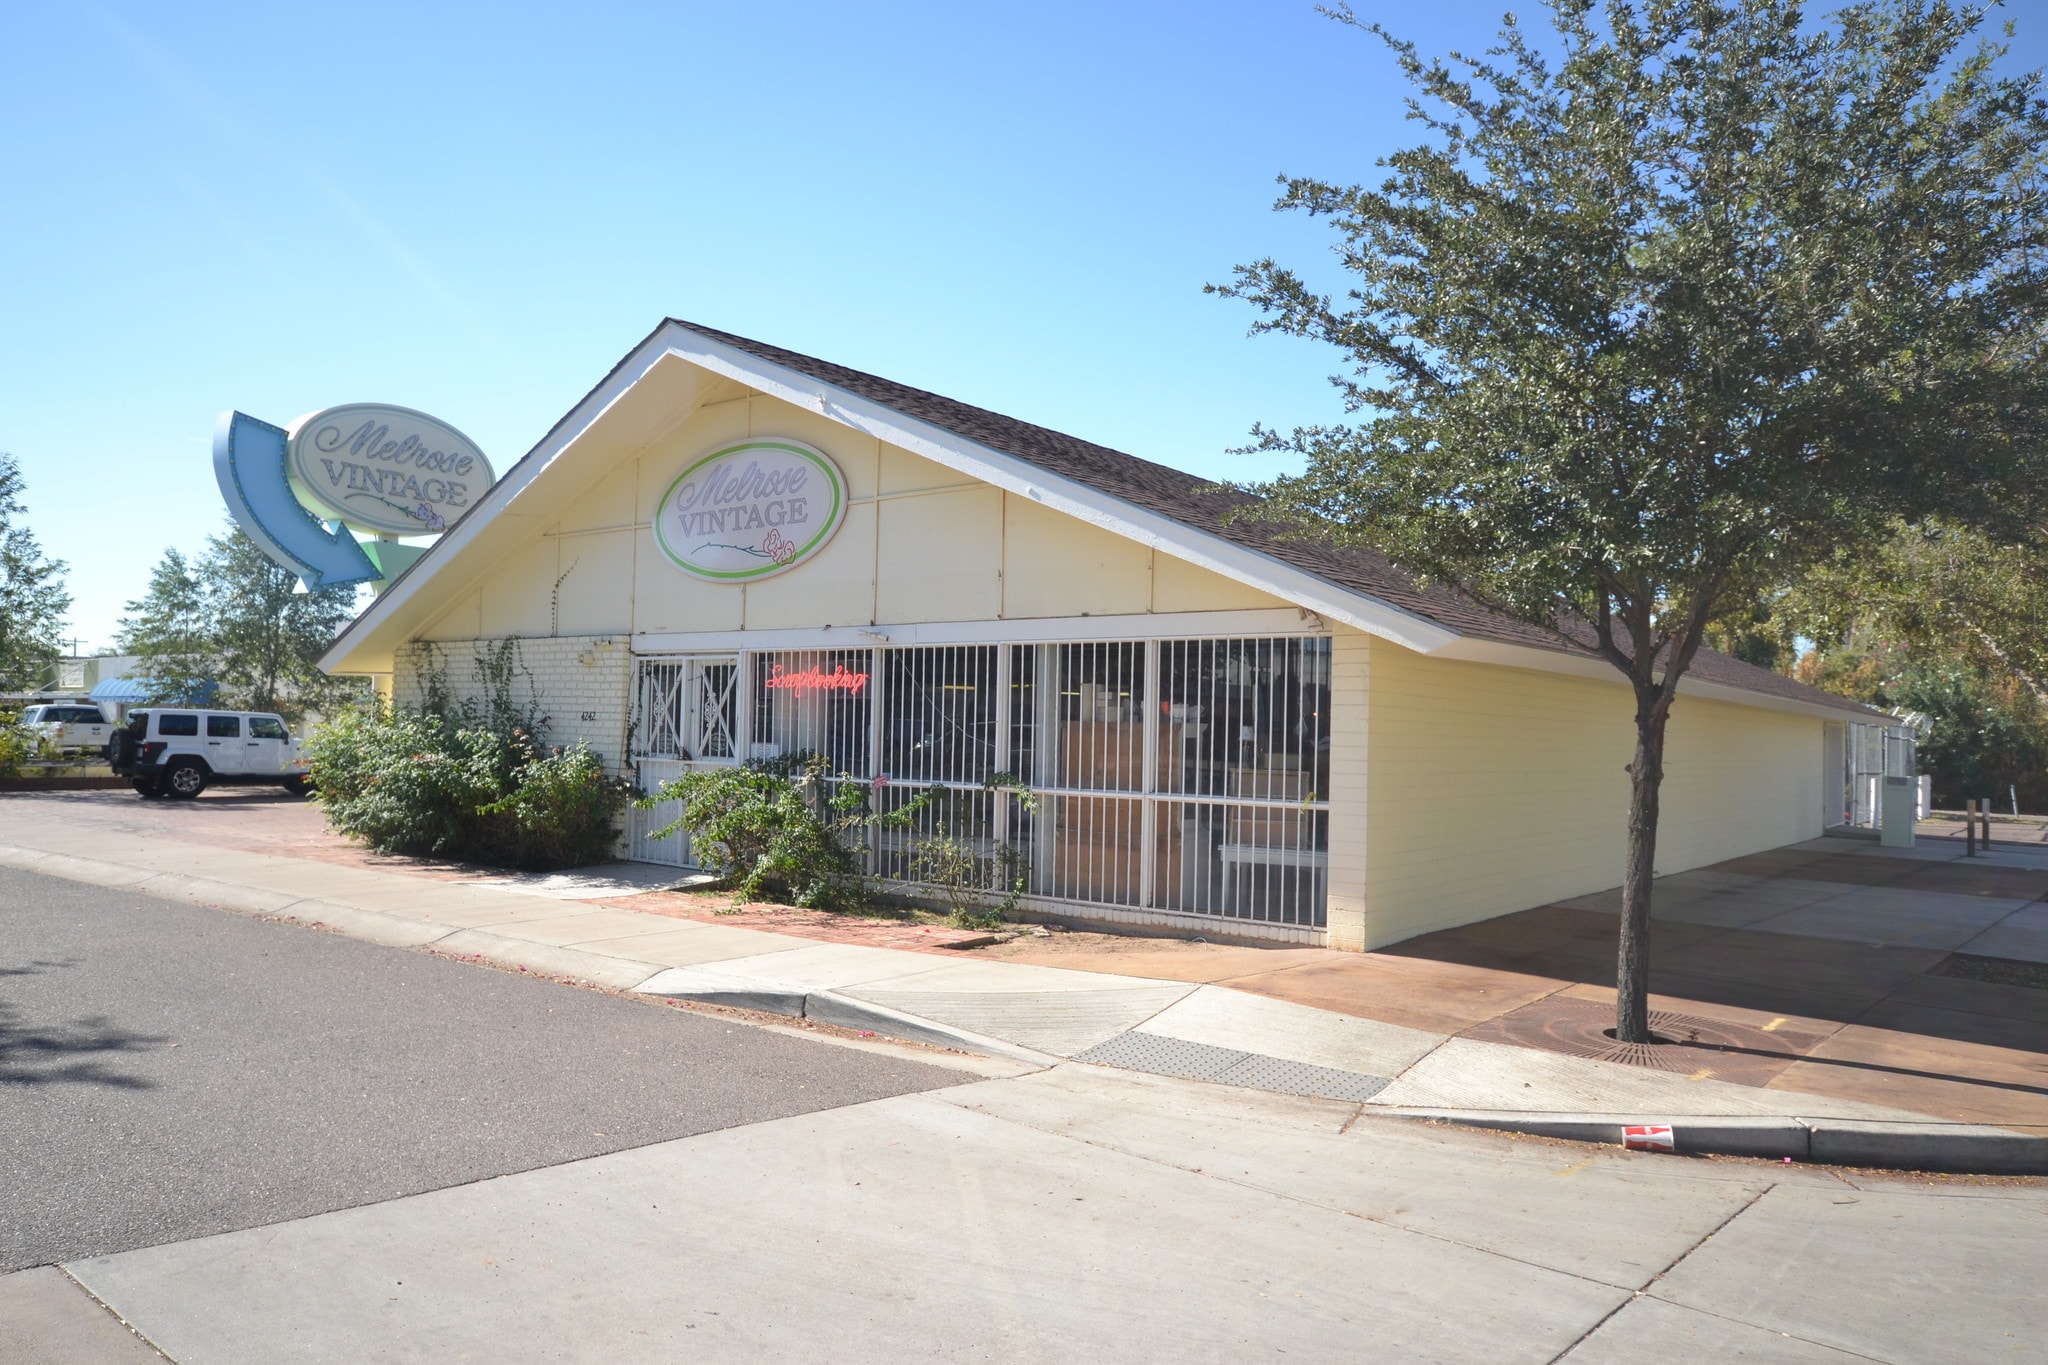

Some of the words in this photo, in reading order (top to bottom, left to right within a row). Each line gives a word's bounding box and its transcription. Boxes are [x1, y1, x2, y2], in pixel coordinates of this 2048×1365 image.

[315, 419, 474, 477] Melrose
[320, 457, 468, 508] VINTAGE
[676, 460, 808, 512] Melrose
[678, 497, 809, 538] VINTAGE
[766, 664, 869, 698] Scrapbooking
